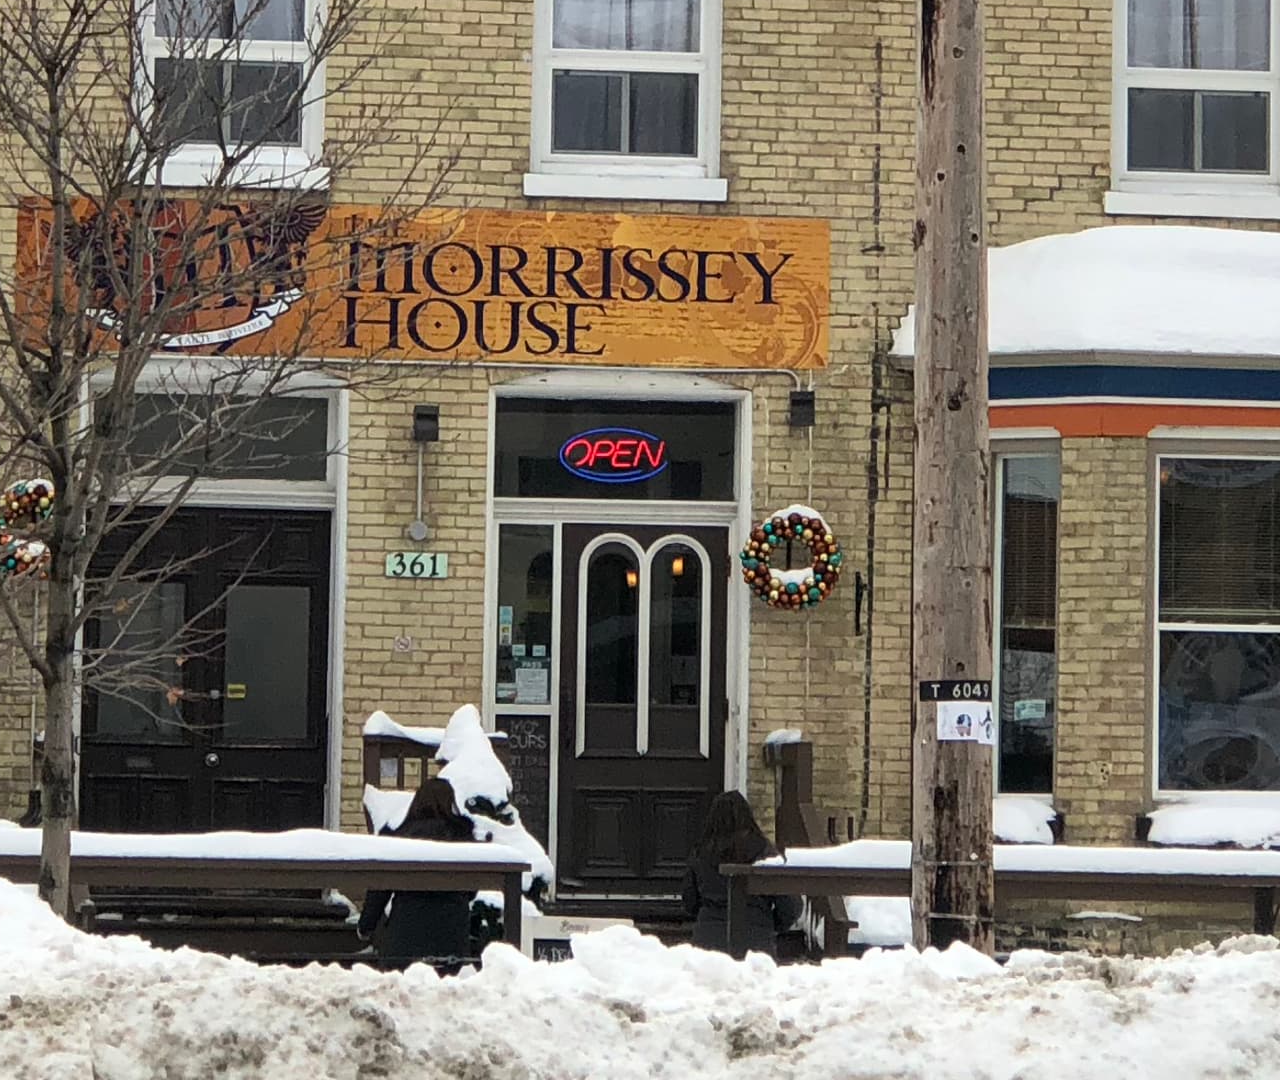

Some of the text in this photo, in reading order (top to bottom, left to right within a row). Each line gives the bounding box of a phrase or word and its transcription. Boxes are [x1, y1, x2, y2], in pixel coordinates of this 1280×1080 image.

[345, 241, 794, 305] MORRISSEY
[339, 296, 606, 355] HOUSE
[564, 438, 665, 467] OPEN
[392, 552, 439, 577] 361
[931, 683, 989, 698] T 6049
